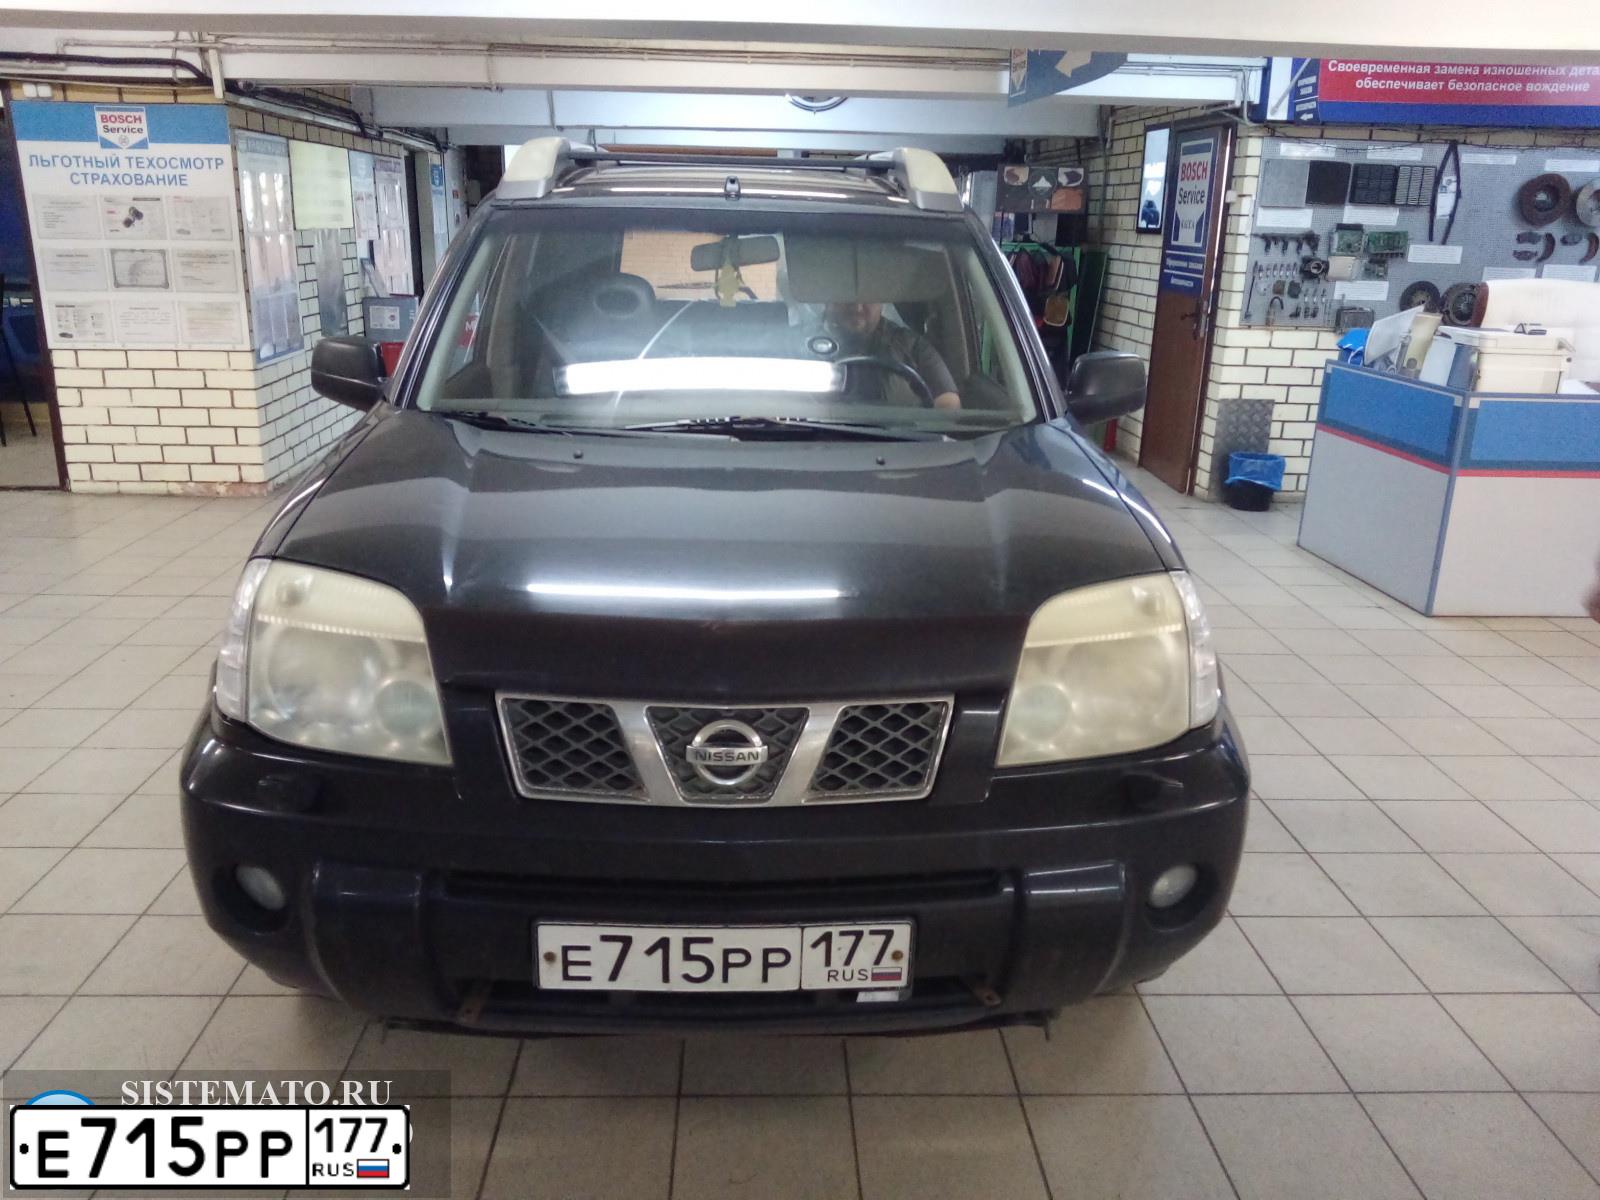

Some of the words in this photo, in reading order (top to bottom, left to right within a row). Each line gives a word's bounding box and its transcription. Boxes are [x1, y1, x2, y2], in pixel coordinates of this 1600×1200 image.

[1328, 60, 1430, 77] Своевременная
[1433, 65, 1480, 77] замена
[1482, 66, 1566, 78] изношенных
[1355, 77, 1446, 92] обеспечивает
[1447, 79, 1522, 92] безопасное
[1525, 83, 1591, 94] вождение
[100, 114, 143, 125] BOSCH
[102, 124, 144, 134] Service
[29, 153, 121, 169] ЛЬГОТНЫЙ
[124, 155, 224, 171] ТЕХОСМОТР
[69, 172, 189, 187] СТРАХОВАНИЕ
[1180, 160, 1208, 183] BOSCH
[1178, 185, 1205, 205] Service
[695, 751, 760, 762] NISSAN
[810, 928, 894, 967] 177
[827, 968, 869, 982] RUS
